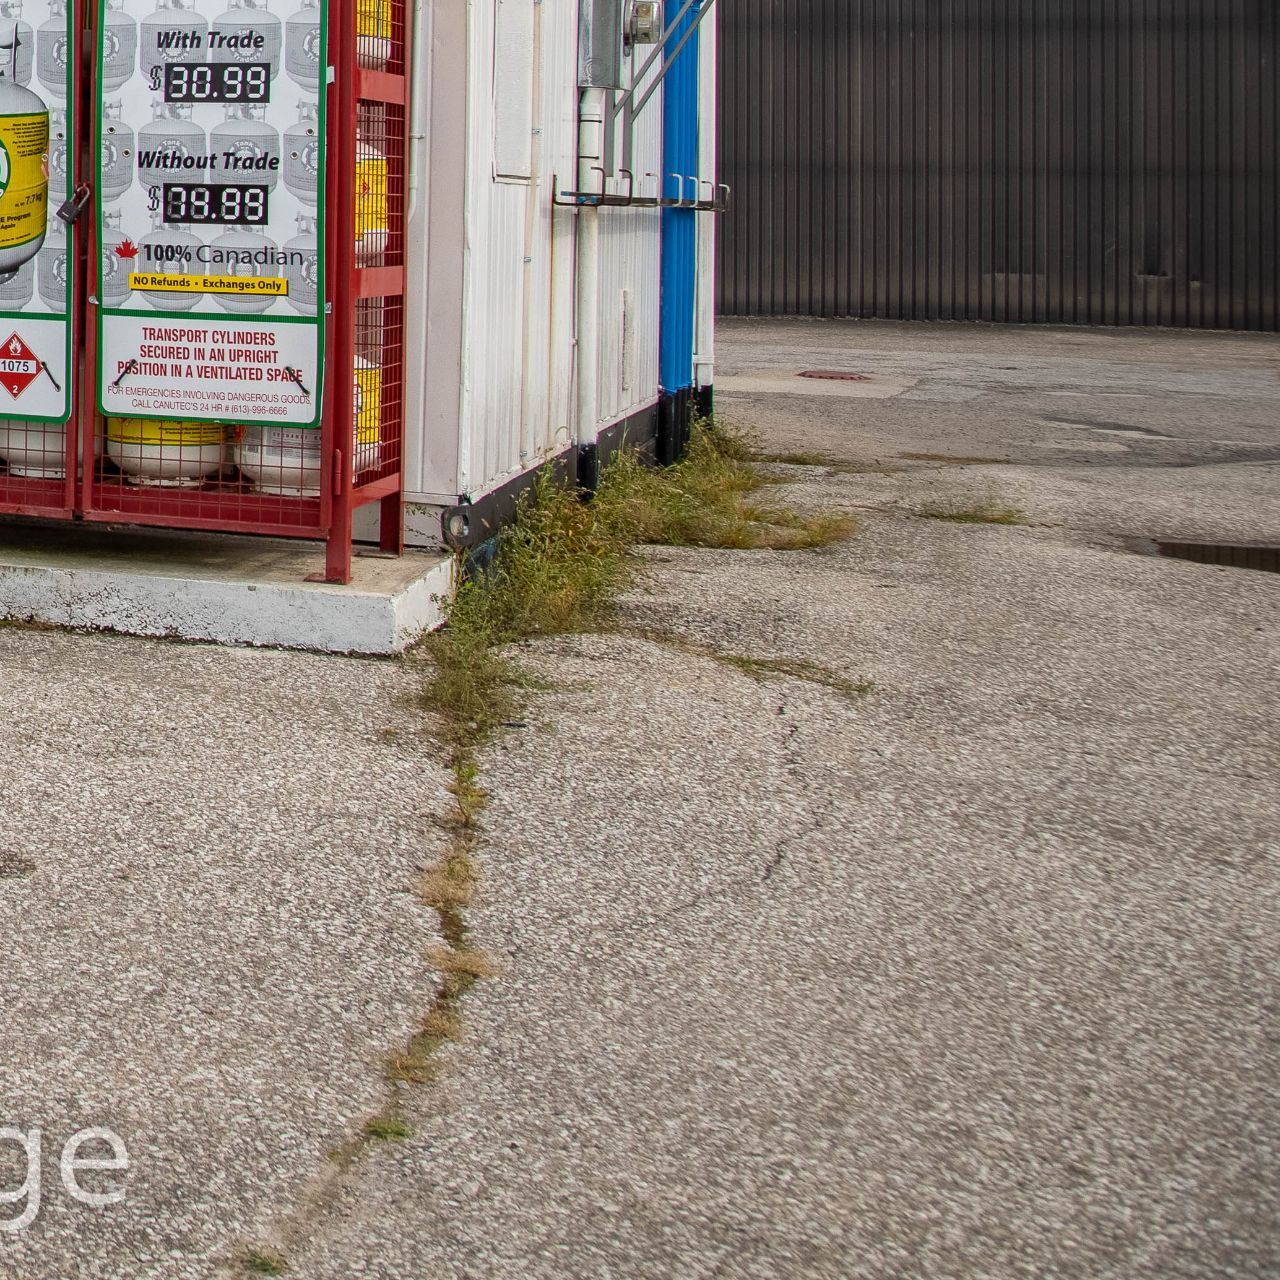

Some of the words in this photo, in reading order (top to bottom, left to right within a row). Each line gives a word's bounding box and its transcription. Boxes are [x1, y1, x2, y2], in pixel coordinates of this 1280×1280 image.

[157, 30, 202, 49] With
[208, 30, 265, 49] Trade
[138, 150, 217, 170] Without
[223, 152, 280, 171] Trade
[144, 244, 192, 262] 100%
[196, 244, 303, 266] Canadian
[134, 276, 149, 286] NO
[150, 277, 191, 287] Refunds
[202, 278, 256, 290] Exchanges
[258, 280, 282, 292] Only
[142, 327, 208, 344] TRANSPORT
[212, 330, 276, 346] CYLINDERS
[140, 345, 190, 361] SECURED
[194, 348, 205, 361] IN
[210, 348, 225, 362] AN
[228, 349, 279, 364] UPRIGHT
[1, 360, 30, 372] 1075
[118, 361, 167, 377] POSITION
[170, 364, 182, 377] IN
[186, 365, 193, 378] A
[196, 365, 263, 381] VENTILATED
[12, 385, 18, 394] 2
[108, 386, 123, 395] FOR
[126, 387, 181, 399] EMERGENCIES
[183, 390, 225, 401] INVOLVING
[227, 392, 279, 403] DANGEROUS
[132, 399, 151, 409] CALL
[153, 400, 198, 412] CANUTEC'S
[200, 402, 209, 412] 24
[212, 404, 223, 412] HR
[231, 404, 288, 416] (613)-996-6666
